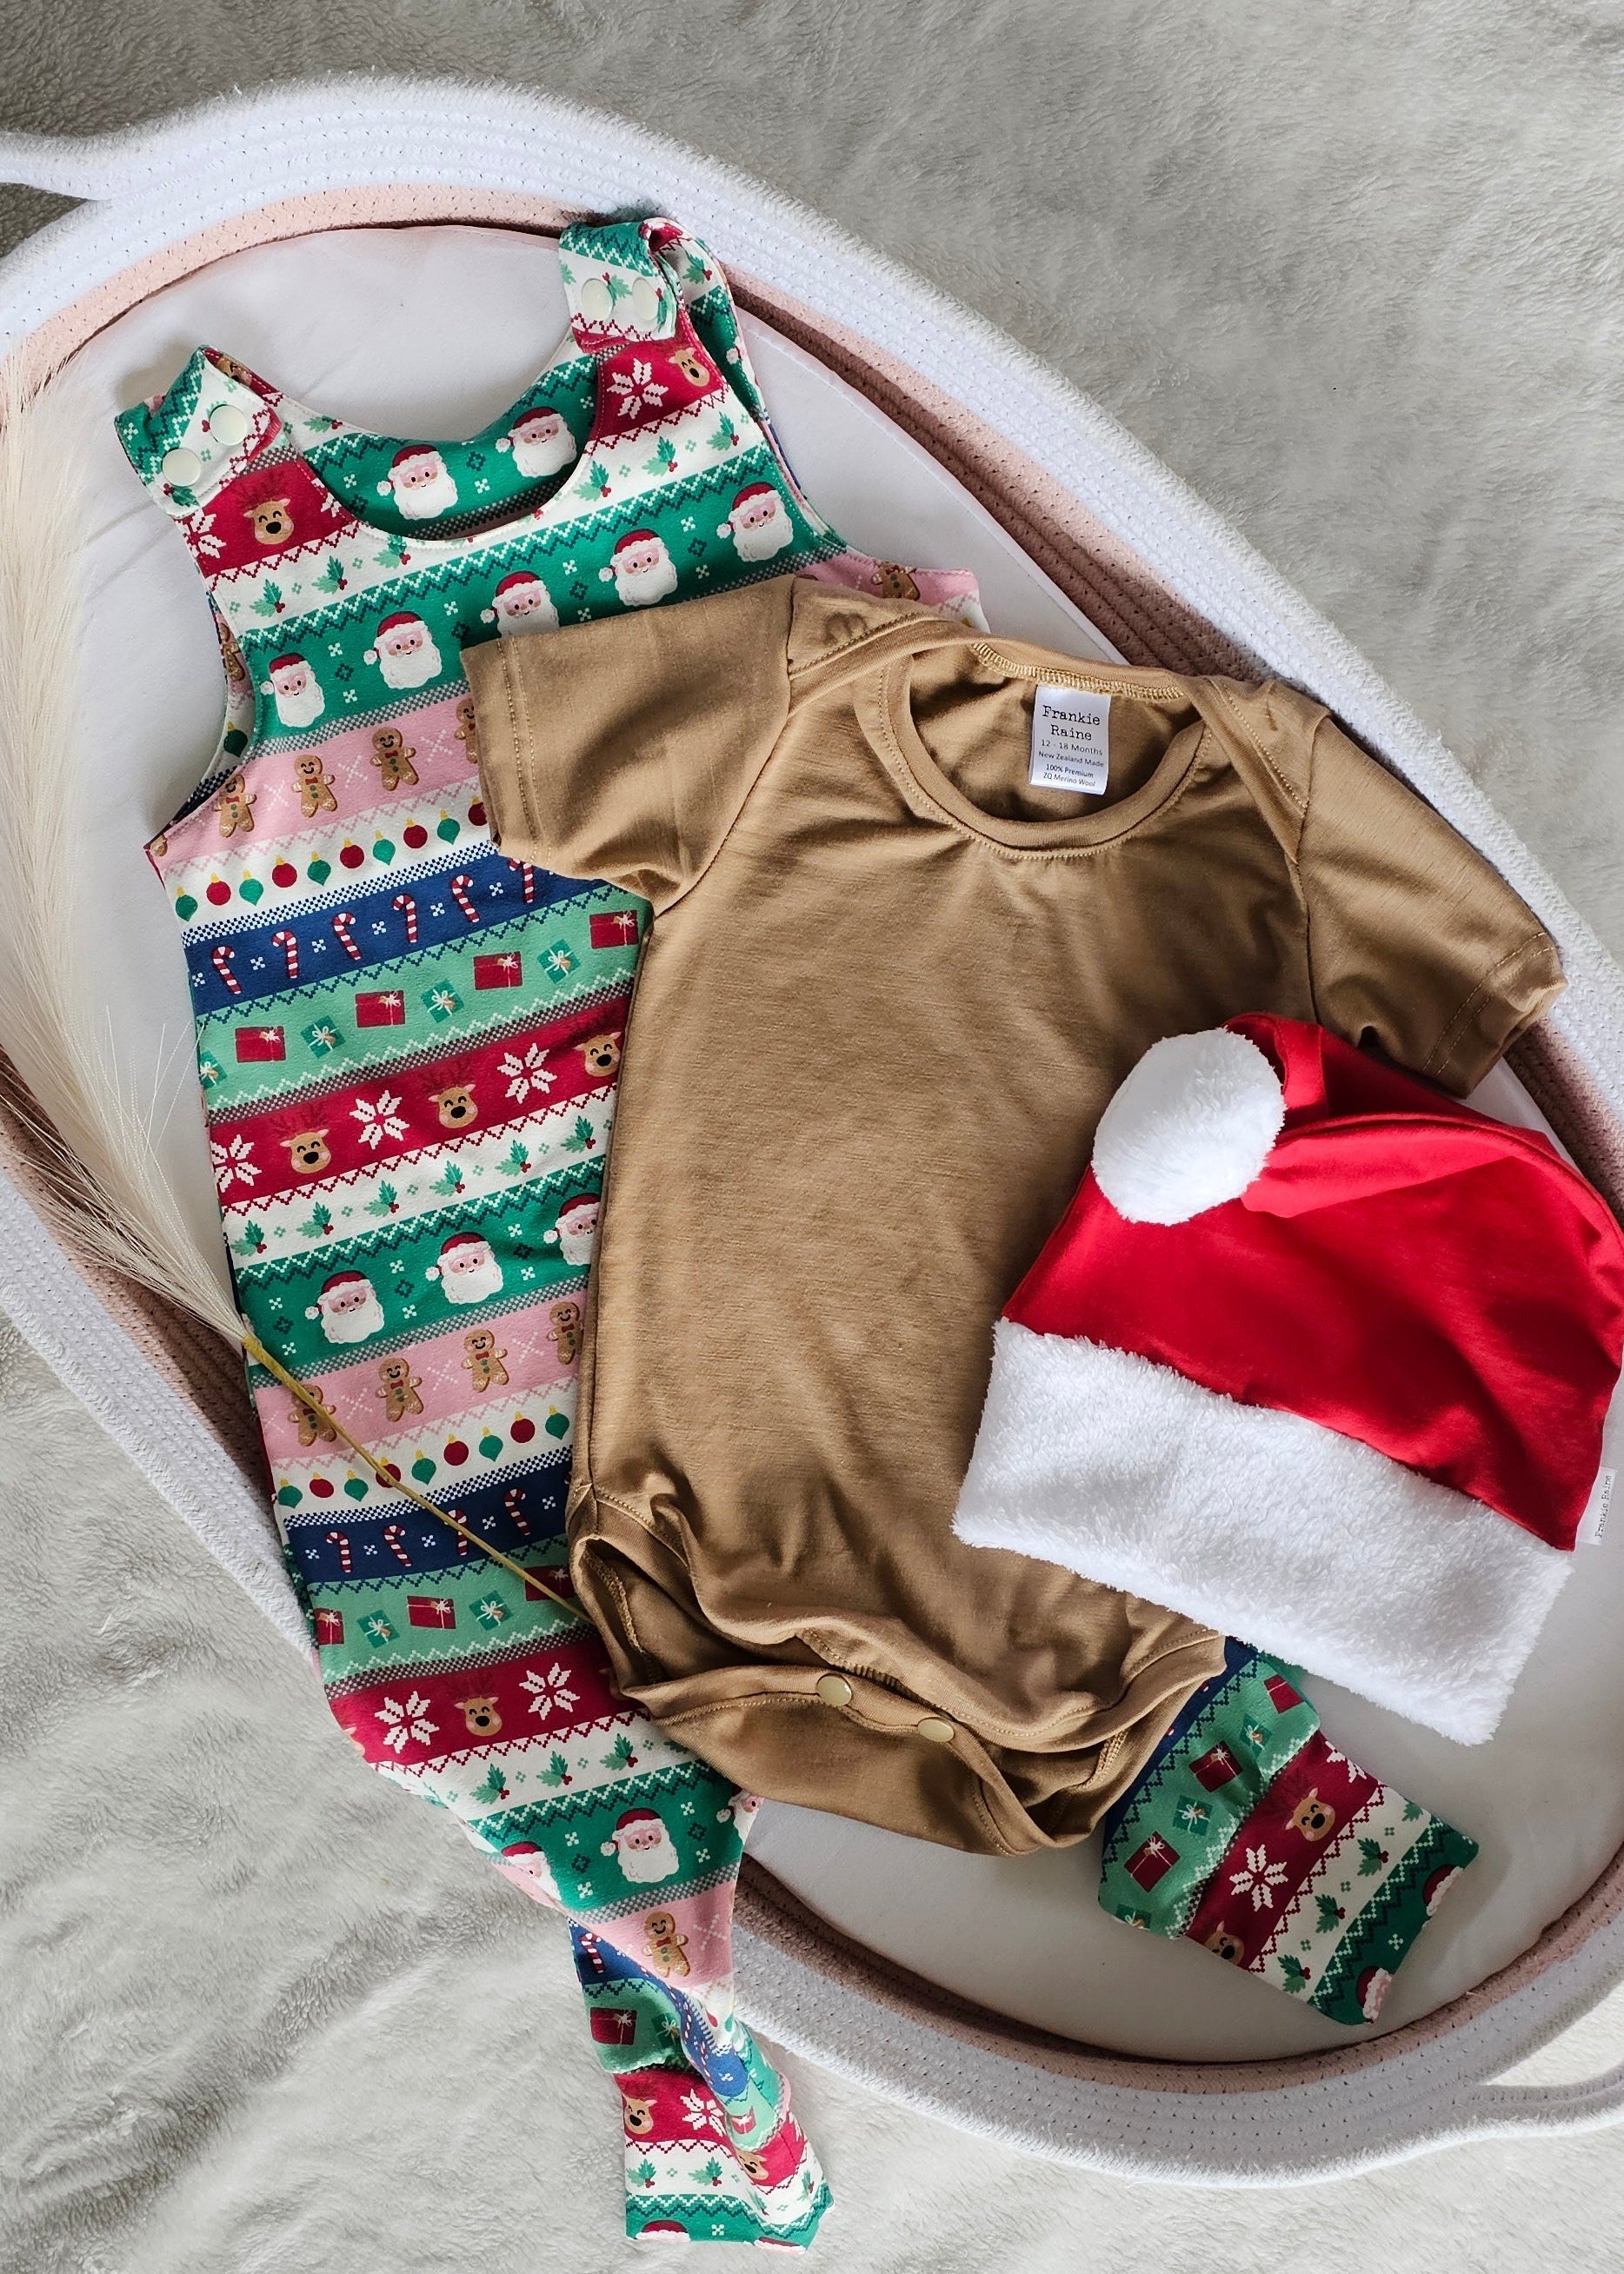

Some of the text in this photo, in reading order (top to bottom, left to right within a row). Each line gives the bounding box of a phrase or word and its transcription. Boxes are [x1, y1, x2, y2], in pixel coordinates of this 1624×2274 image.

[1042, 704, 1101, 725] Frankie
[1050, 724, 1092, 741] Raine
[1071, 744, 1103, 755] Months
[1038, 750, 1104, 768] New Zealand Made
[1046, 763, 1094, 778] 100% Premium
[1054, 774, 1077, 784] Merino
